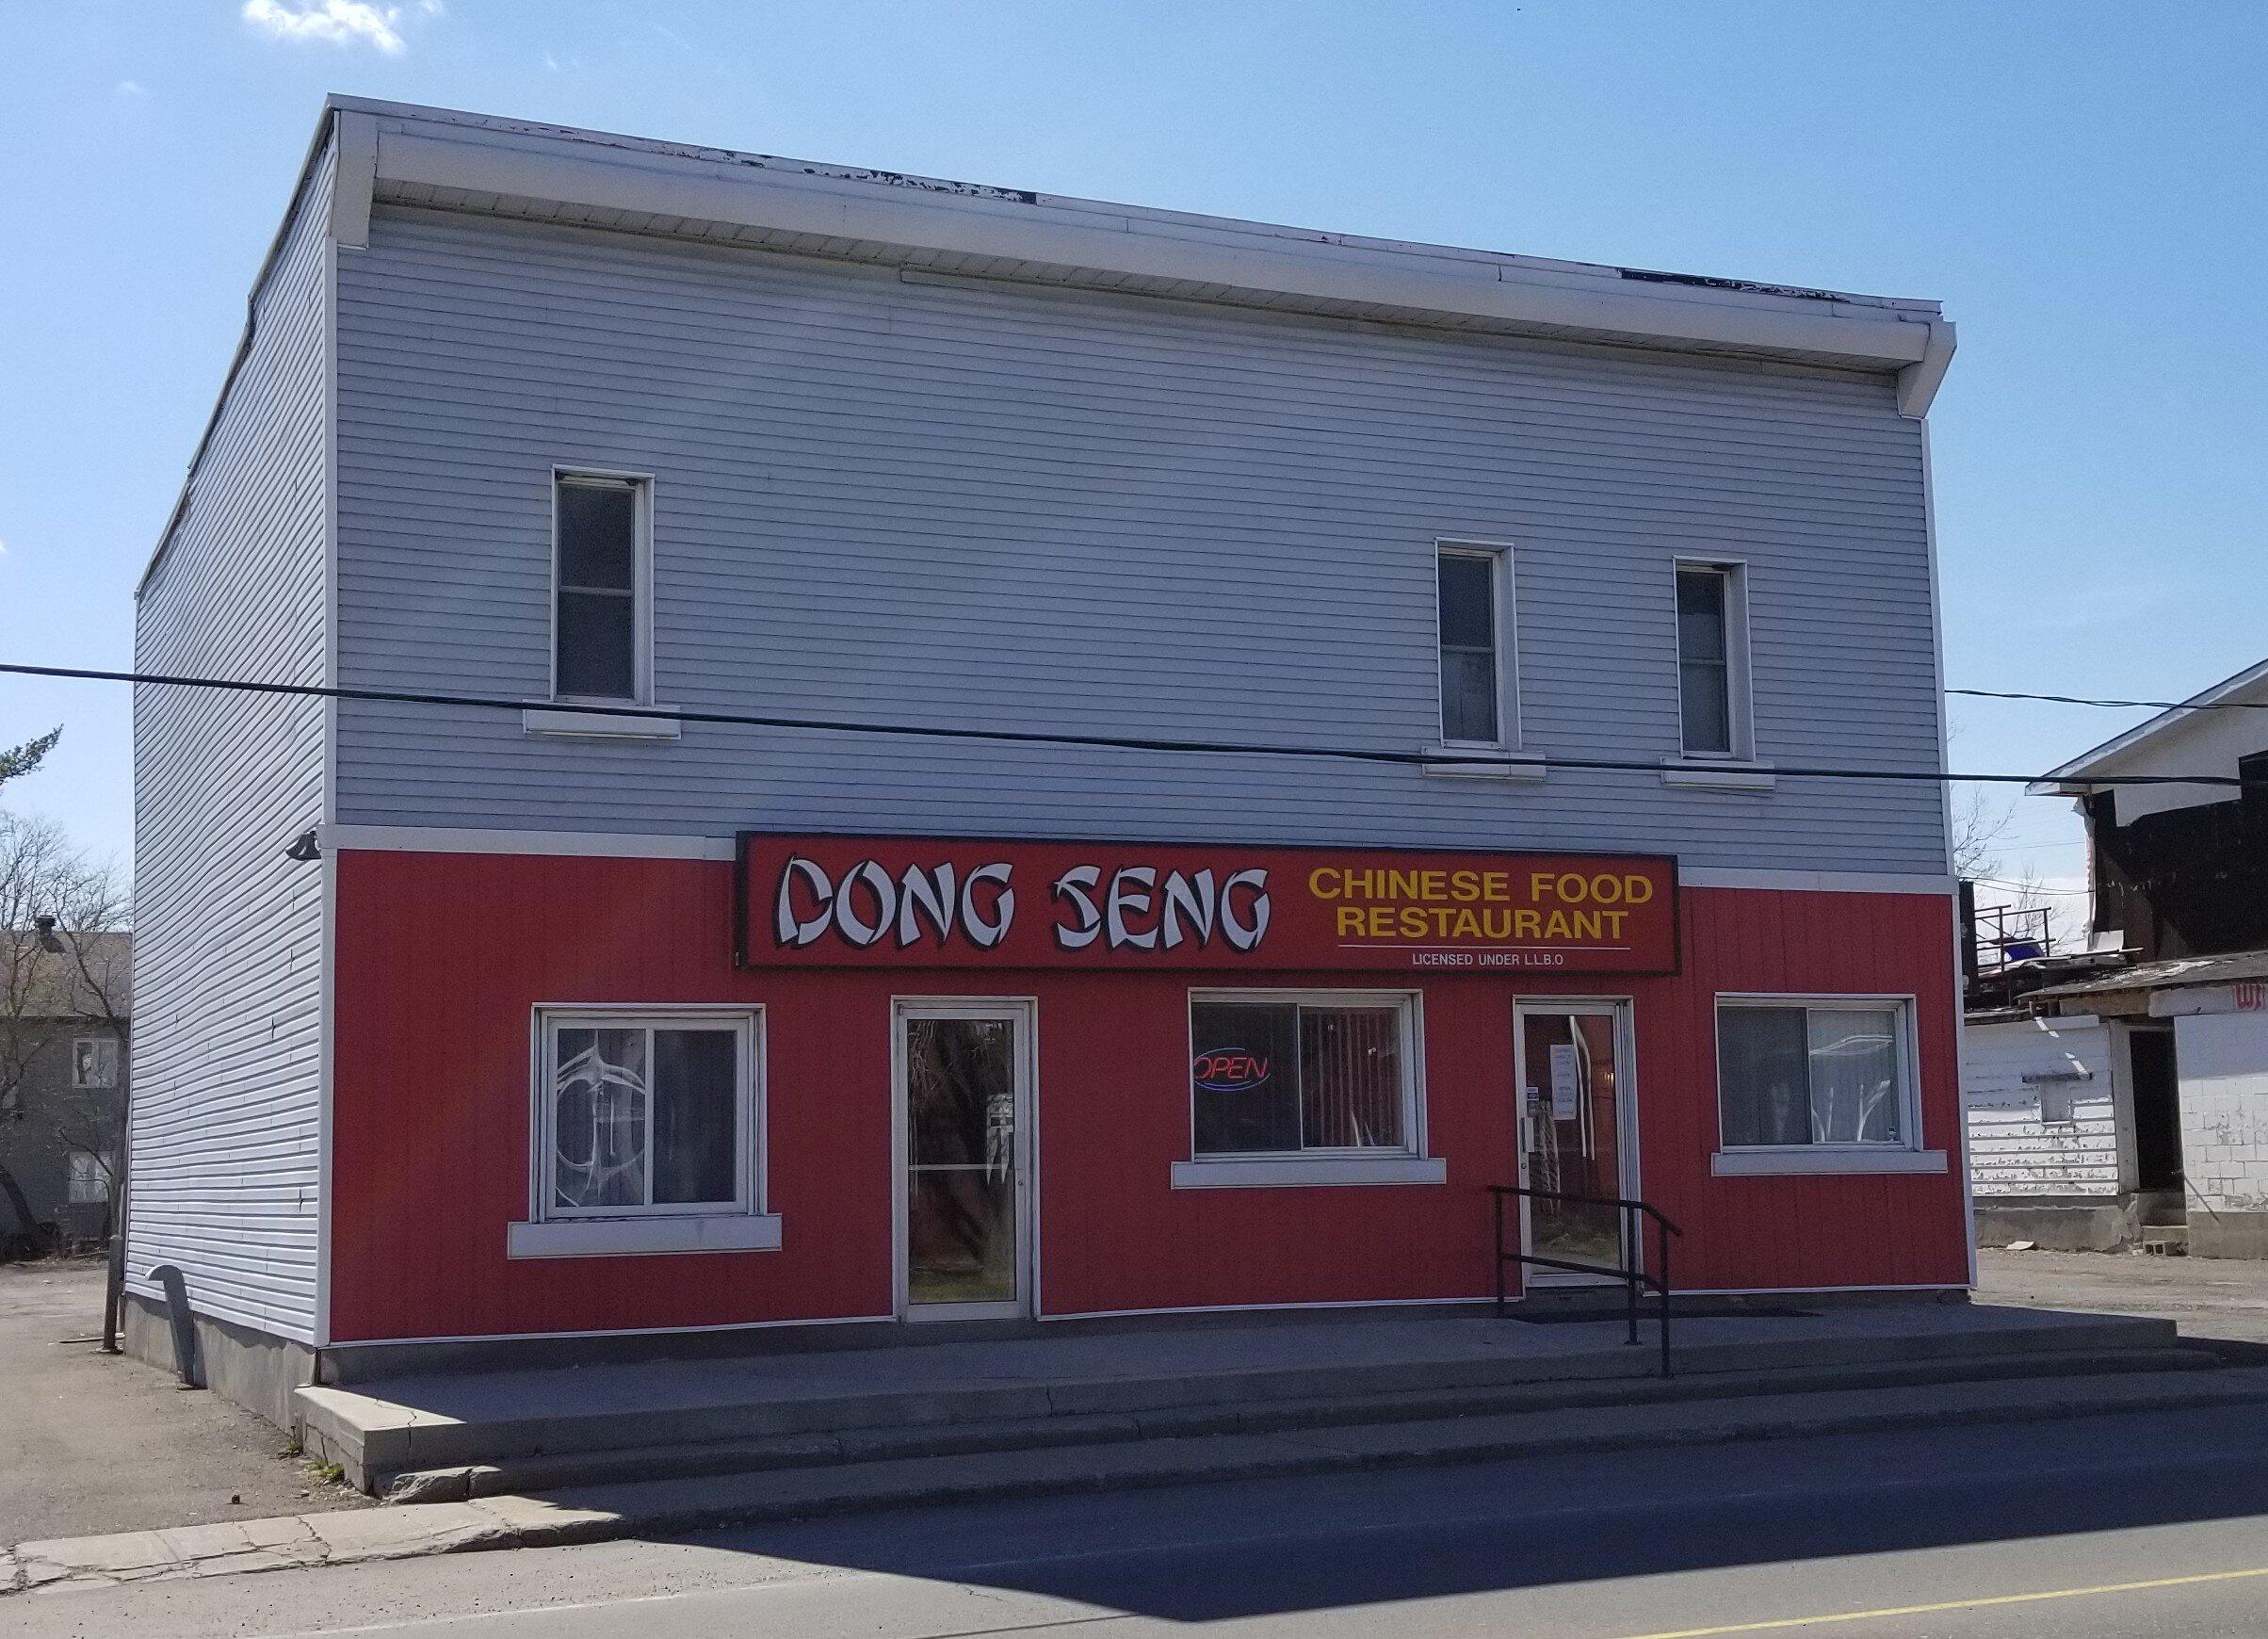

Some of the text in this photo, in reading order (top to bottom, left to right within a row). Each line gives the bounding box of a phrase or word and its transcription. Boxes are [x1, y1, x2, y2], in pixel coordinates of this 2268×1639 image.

[777, 854, 1272, 949] DONG SENG
[1308, 868, 1653, 904] CHINESE FOOD
[1336, 906, 1629, 940] RESTAURANT
[1412, 953, 1474, 966] LICENSED
[1478, 954, 1520, 966] UNDER
[1193, 1057, 1268, 1079] OPEN
